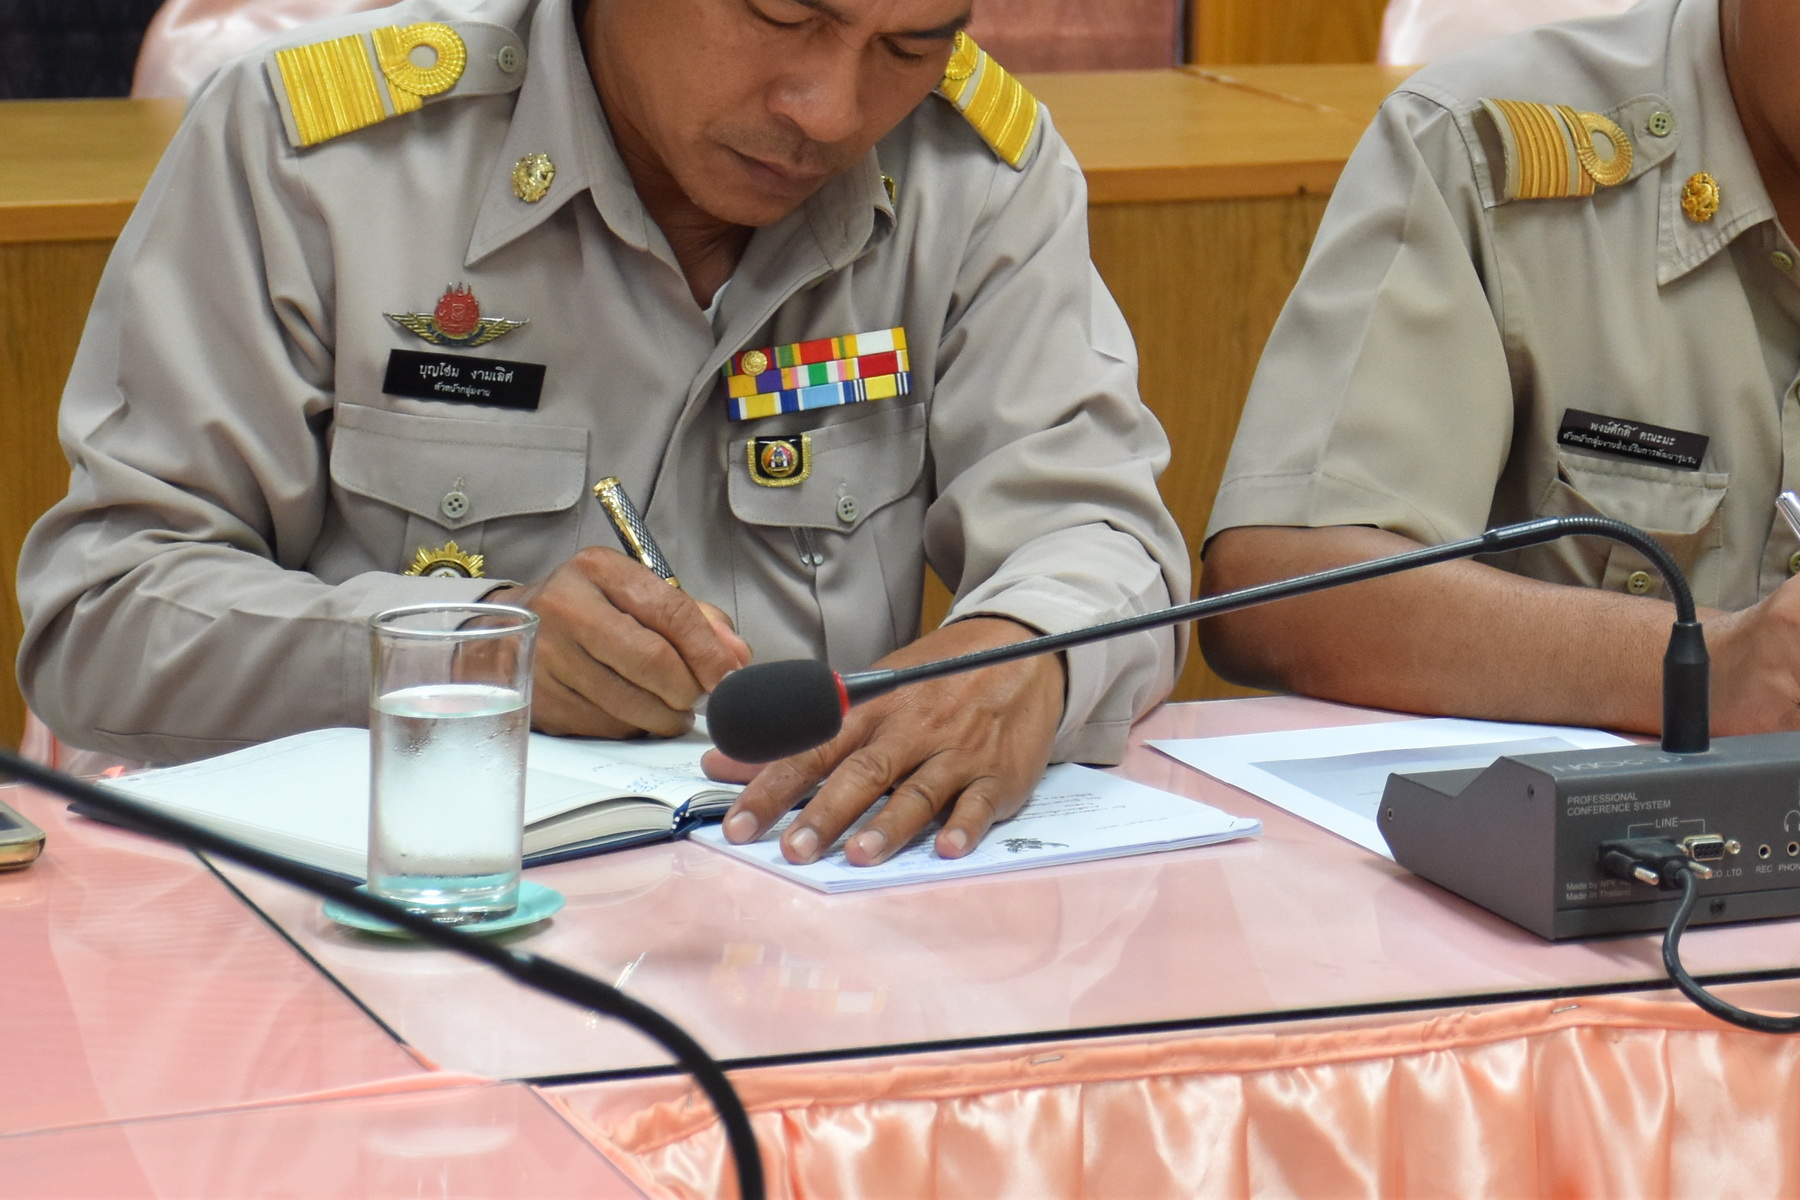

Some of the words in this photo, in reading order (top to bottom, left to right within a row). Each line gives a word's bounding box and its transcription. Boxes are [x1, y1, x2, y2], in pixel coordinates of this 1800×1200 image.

[470, 366, 514, 383] งามเลิศ
[1590, 421, 1639, 438] พงษ์ศักดิ์
[1567, 792, 1638, 806] PROFESSIONAL
[1567, 803, 1631, 817] CONFERENCE
[1633, 799, 1672, 812] SYSTEM
[1655, 816, 1680, 829] LINE
[1756, 864, 1774, 874] REC
[1566, 882, 1588, 891] Made
[1566, 892, 1588, 901] Made
